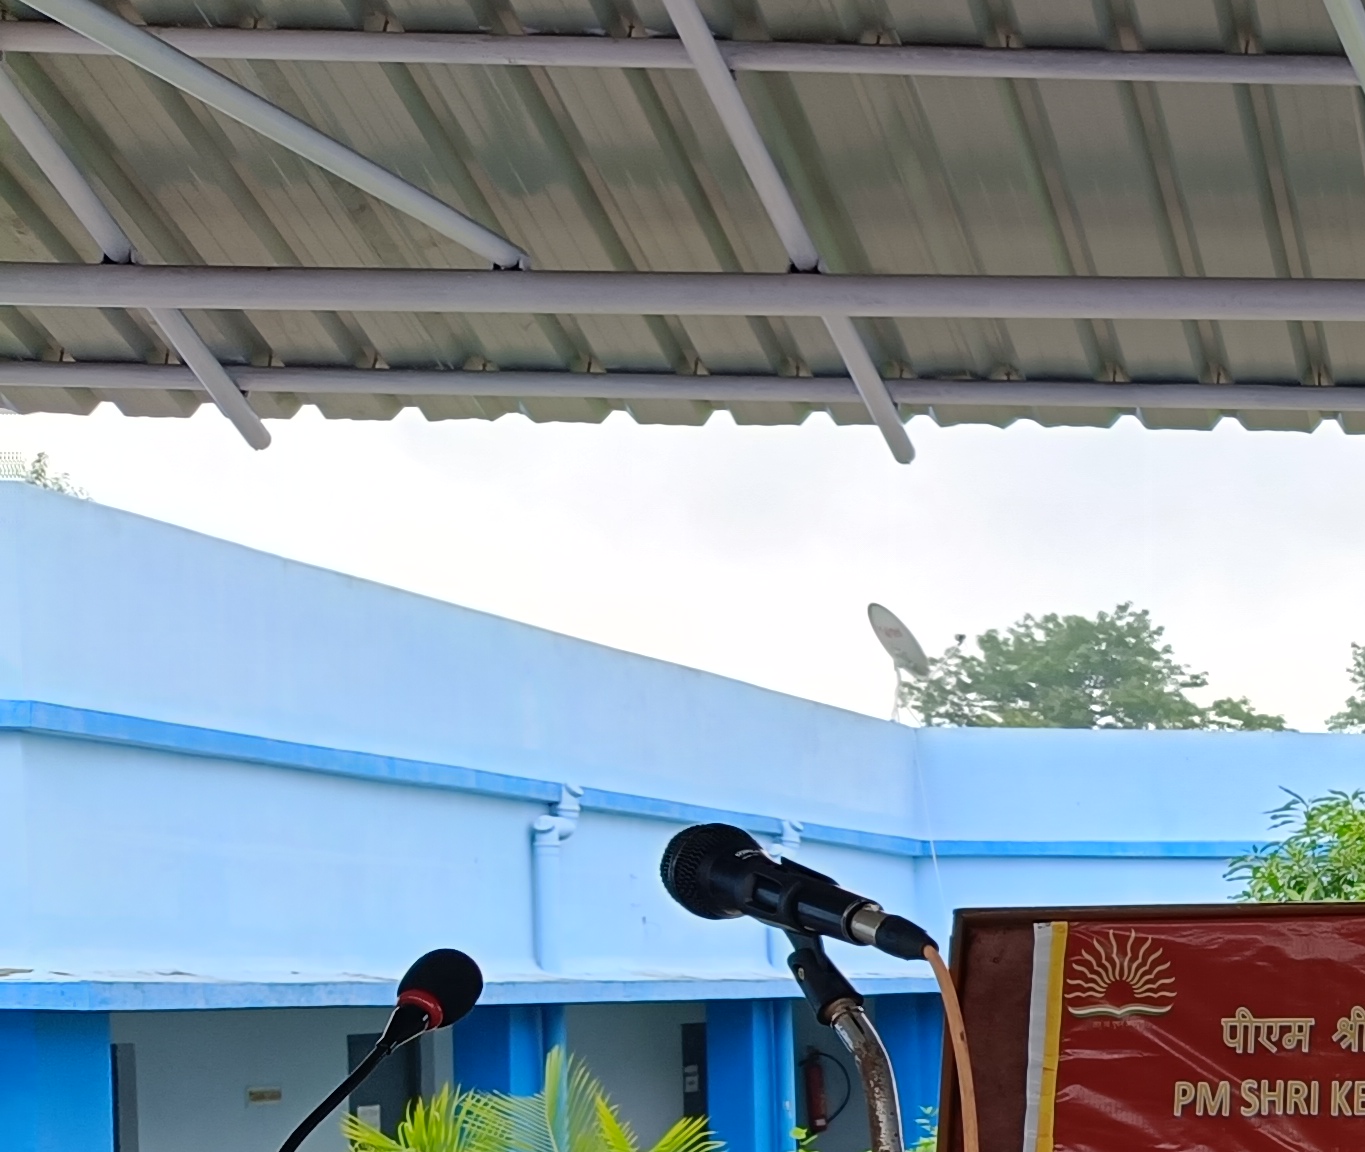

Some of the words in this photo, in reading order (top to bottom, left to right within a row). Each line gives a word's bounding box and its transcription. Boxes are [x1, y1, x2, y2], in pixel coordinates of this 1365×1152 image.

[1221, 1006, 1314, 1053] पीएम
[1173, 1081, 1230, 1117] PM
[1241, 1079, 1319, 1116] SHRI
